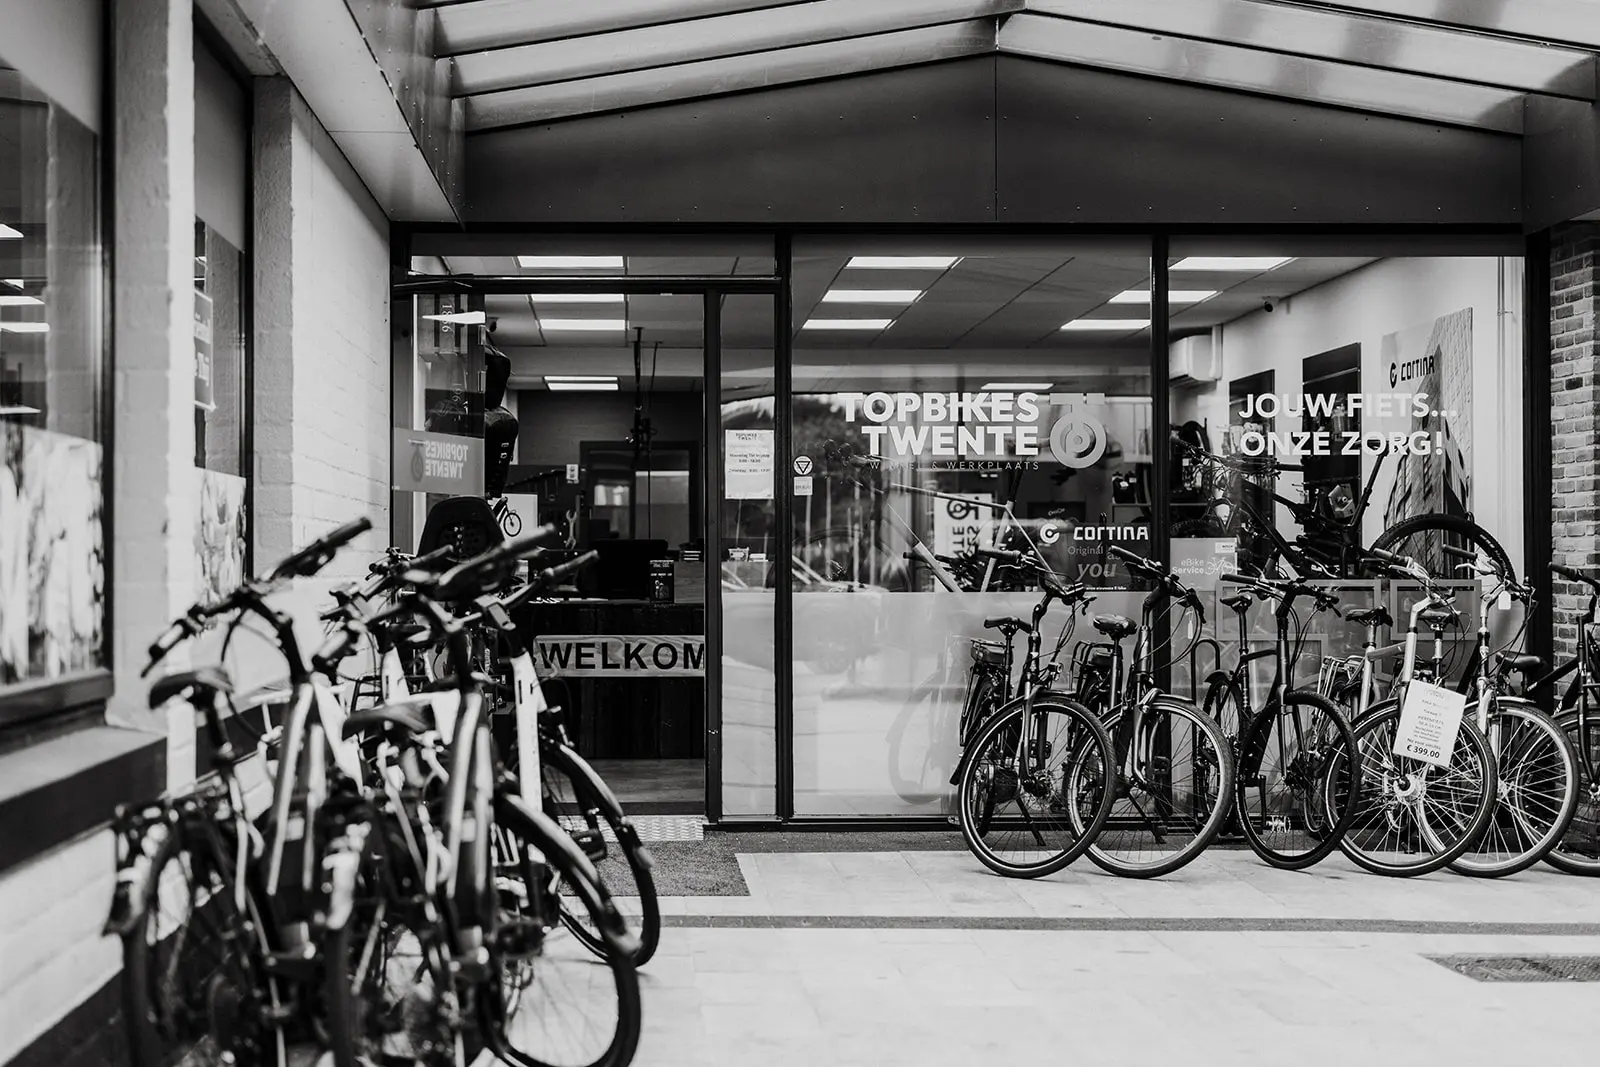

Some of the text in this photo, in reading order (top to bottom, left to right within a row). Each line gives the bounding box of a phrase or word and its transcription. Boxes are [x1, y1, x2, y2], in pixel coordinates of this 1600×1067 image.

[1401, 355, 1435, 381] CORTINA
[836, 391, 1040, 423] TOPBIKES
[1238, 393, 1458, 418] JOUW FIETS...
[861, 425, 1039, 456] TWENTE
[1239, 431, 1444, 456] ONZE ZORG!
[946, 461, 1040, 470] WERKPLAATS
[1073, 526, 1149, 540] CORTINA
[1067, 545, 1104, 556] Original
[1172, 566, 1205, 574] Service
[1180, 558, 1205, 567] eBike
[1075, 563, 1117, 582] you
[539, 642, 705, 670] WELKOM
[1406, 744, 1412, 752] €
